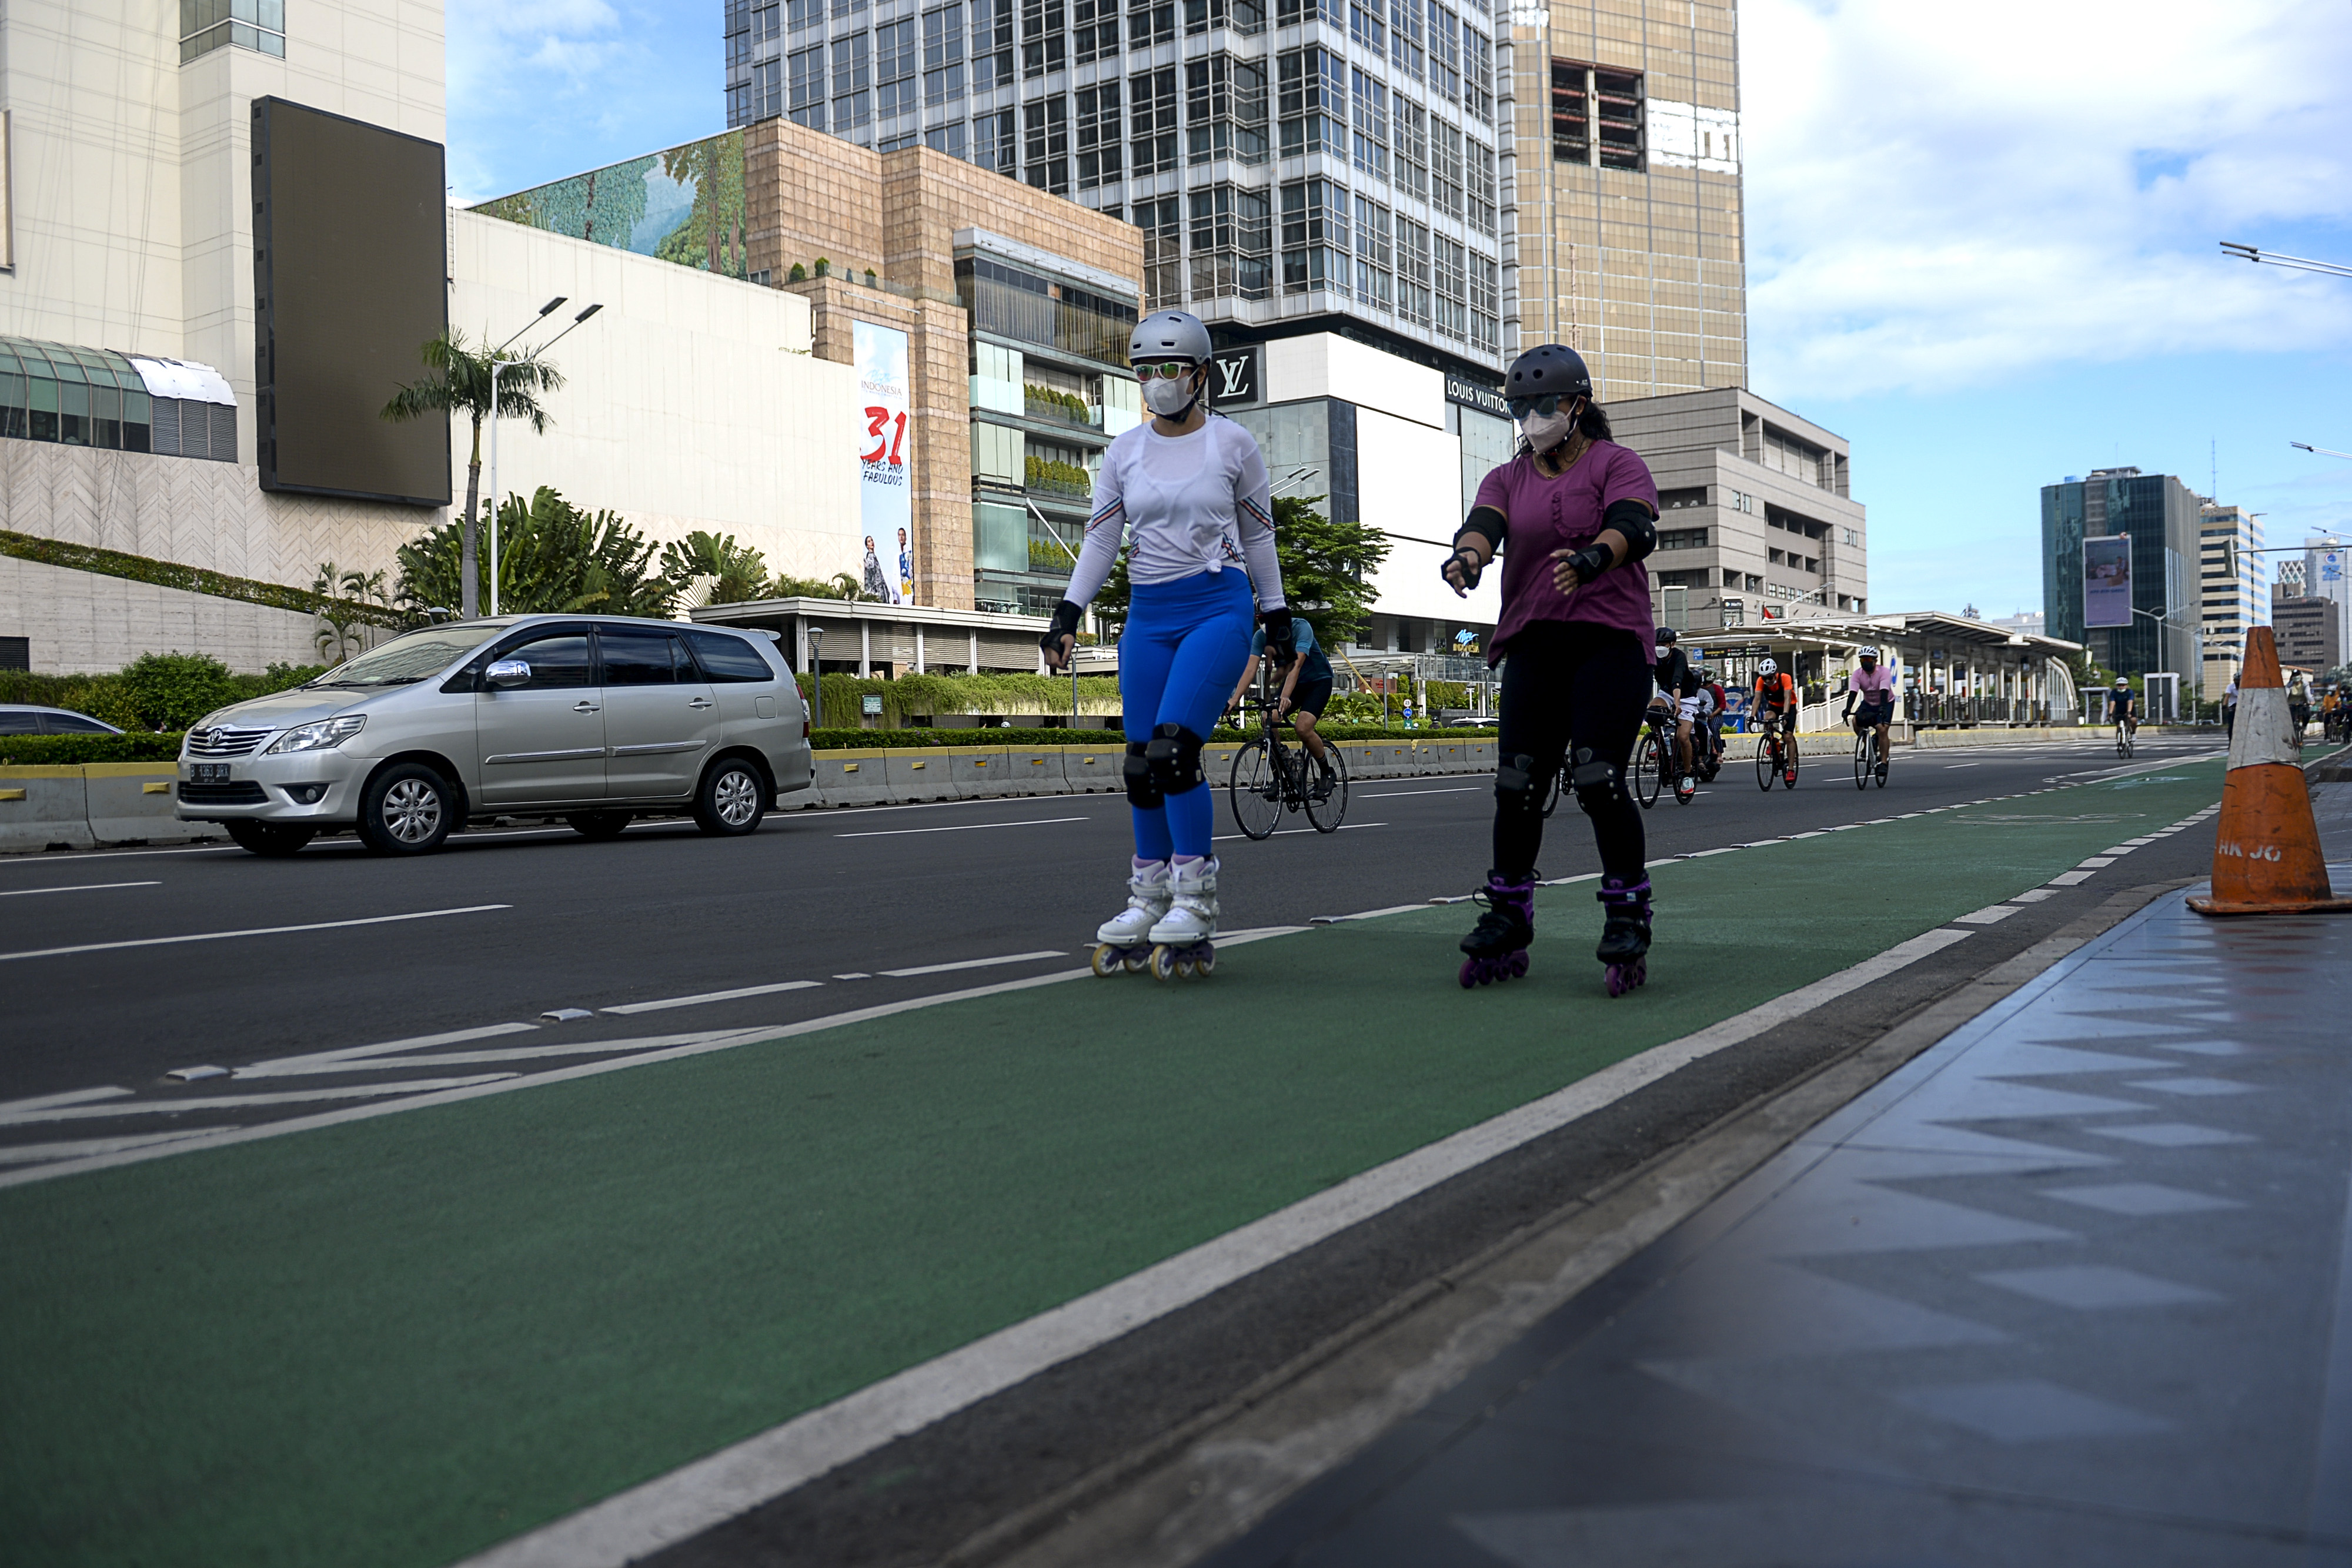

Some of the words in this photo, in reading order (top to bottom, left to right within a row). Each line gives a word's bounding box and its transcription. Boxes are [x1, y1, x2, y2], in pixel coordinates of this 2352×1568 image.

[861, 380, 902, 396] INDONESIA
[1448, 379, 1474, 402] LOUIS
[860, 406, 907, 464] 31
[862, 459, 886, 472] YEARS
[888, 463, 903, 474] AND
[863, 471, 903, 486] FABULOUS
[2219, 840, 2243, 857] HK
